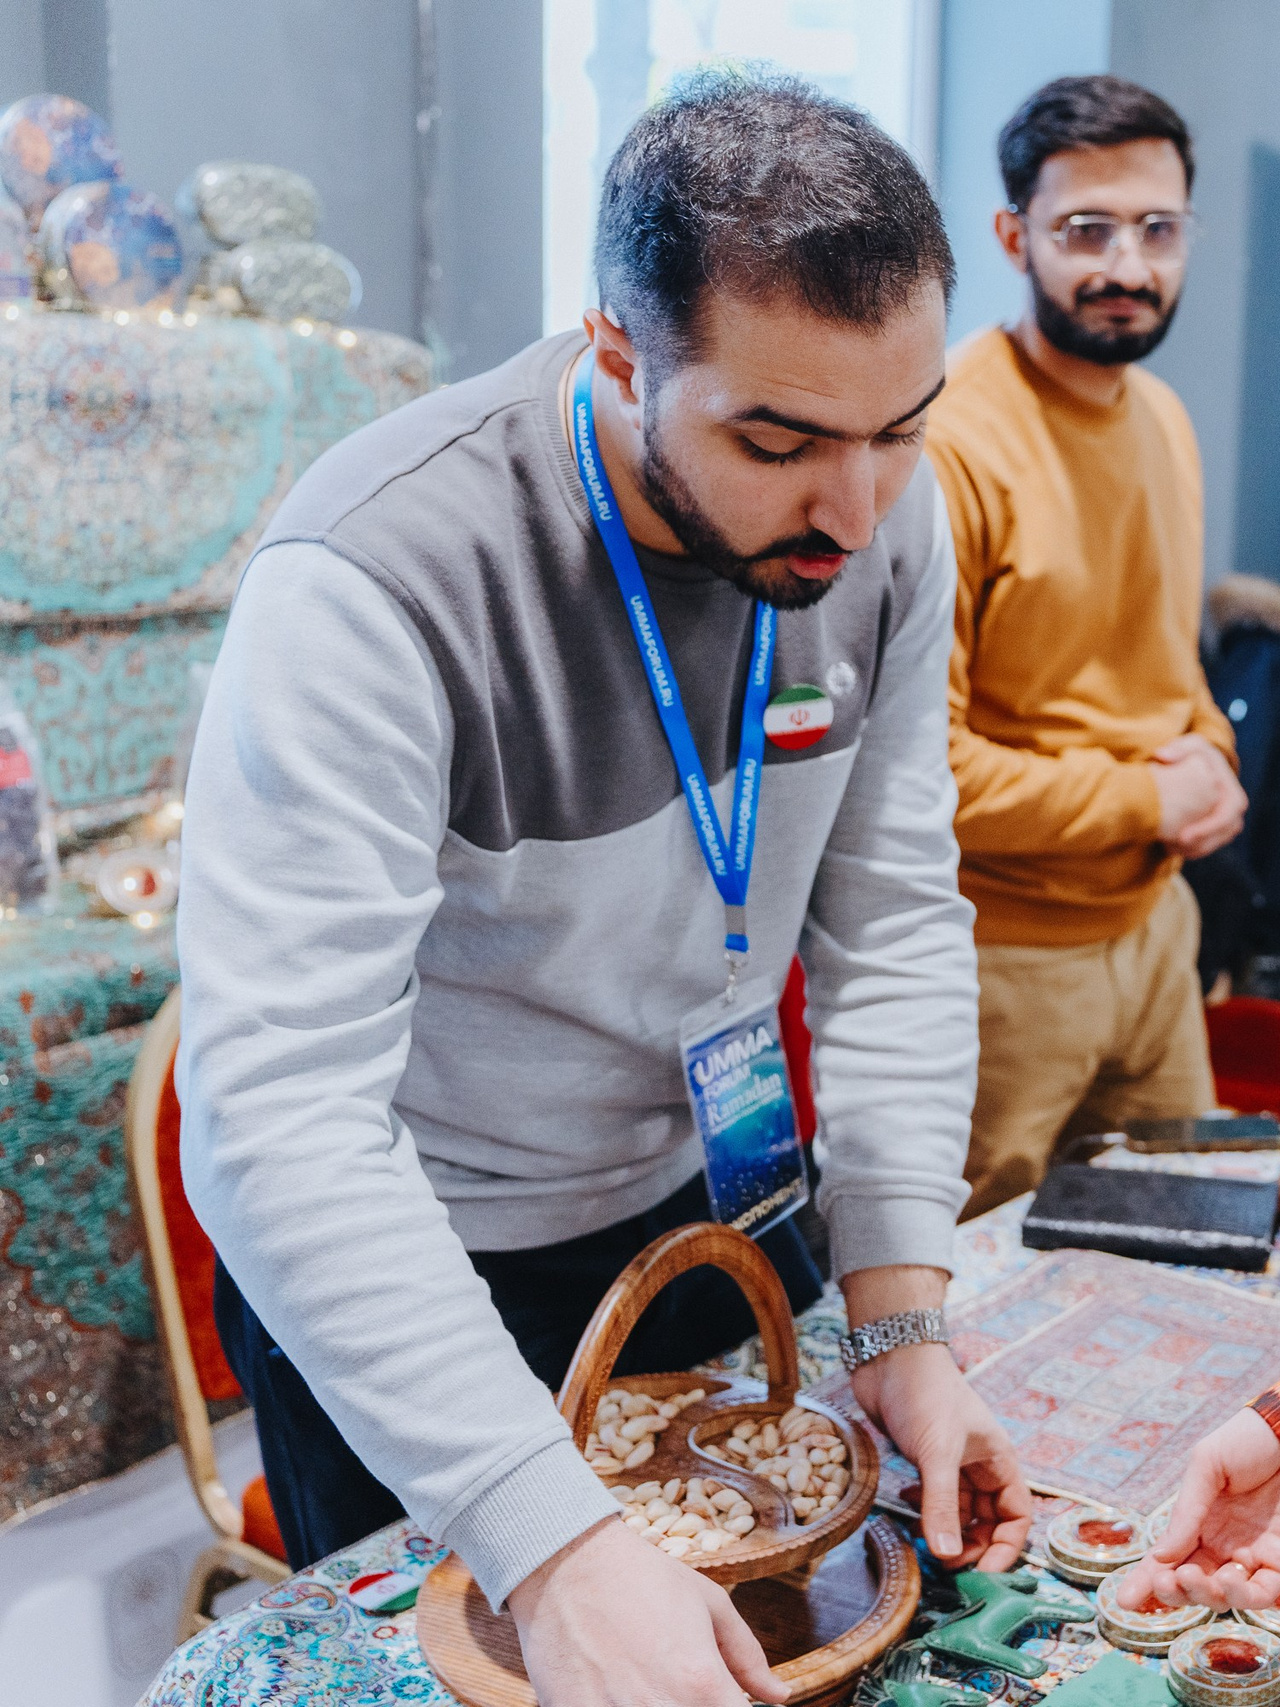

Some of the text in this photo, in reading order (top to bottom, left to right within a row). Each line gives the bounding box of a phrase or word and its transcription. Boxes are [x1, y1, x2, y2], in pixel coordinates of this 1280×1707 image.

[576, 402, 613, 521] UMMAFORUM.RU
[630, 595, 674, 707] UMMAFORUM.RU
[687, 773, 727, 876] UMMAFORUM.RU
[736, 758, 757, 871] UMMAFORUM.RU
[693, 1026, 774, 1087] UMMA
